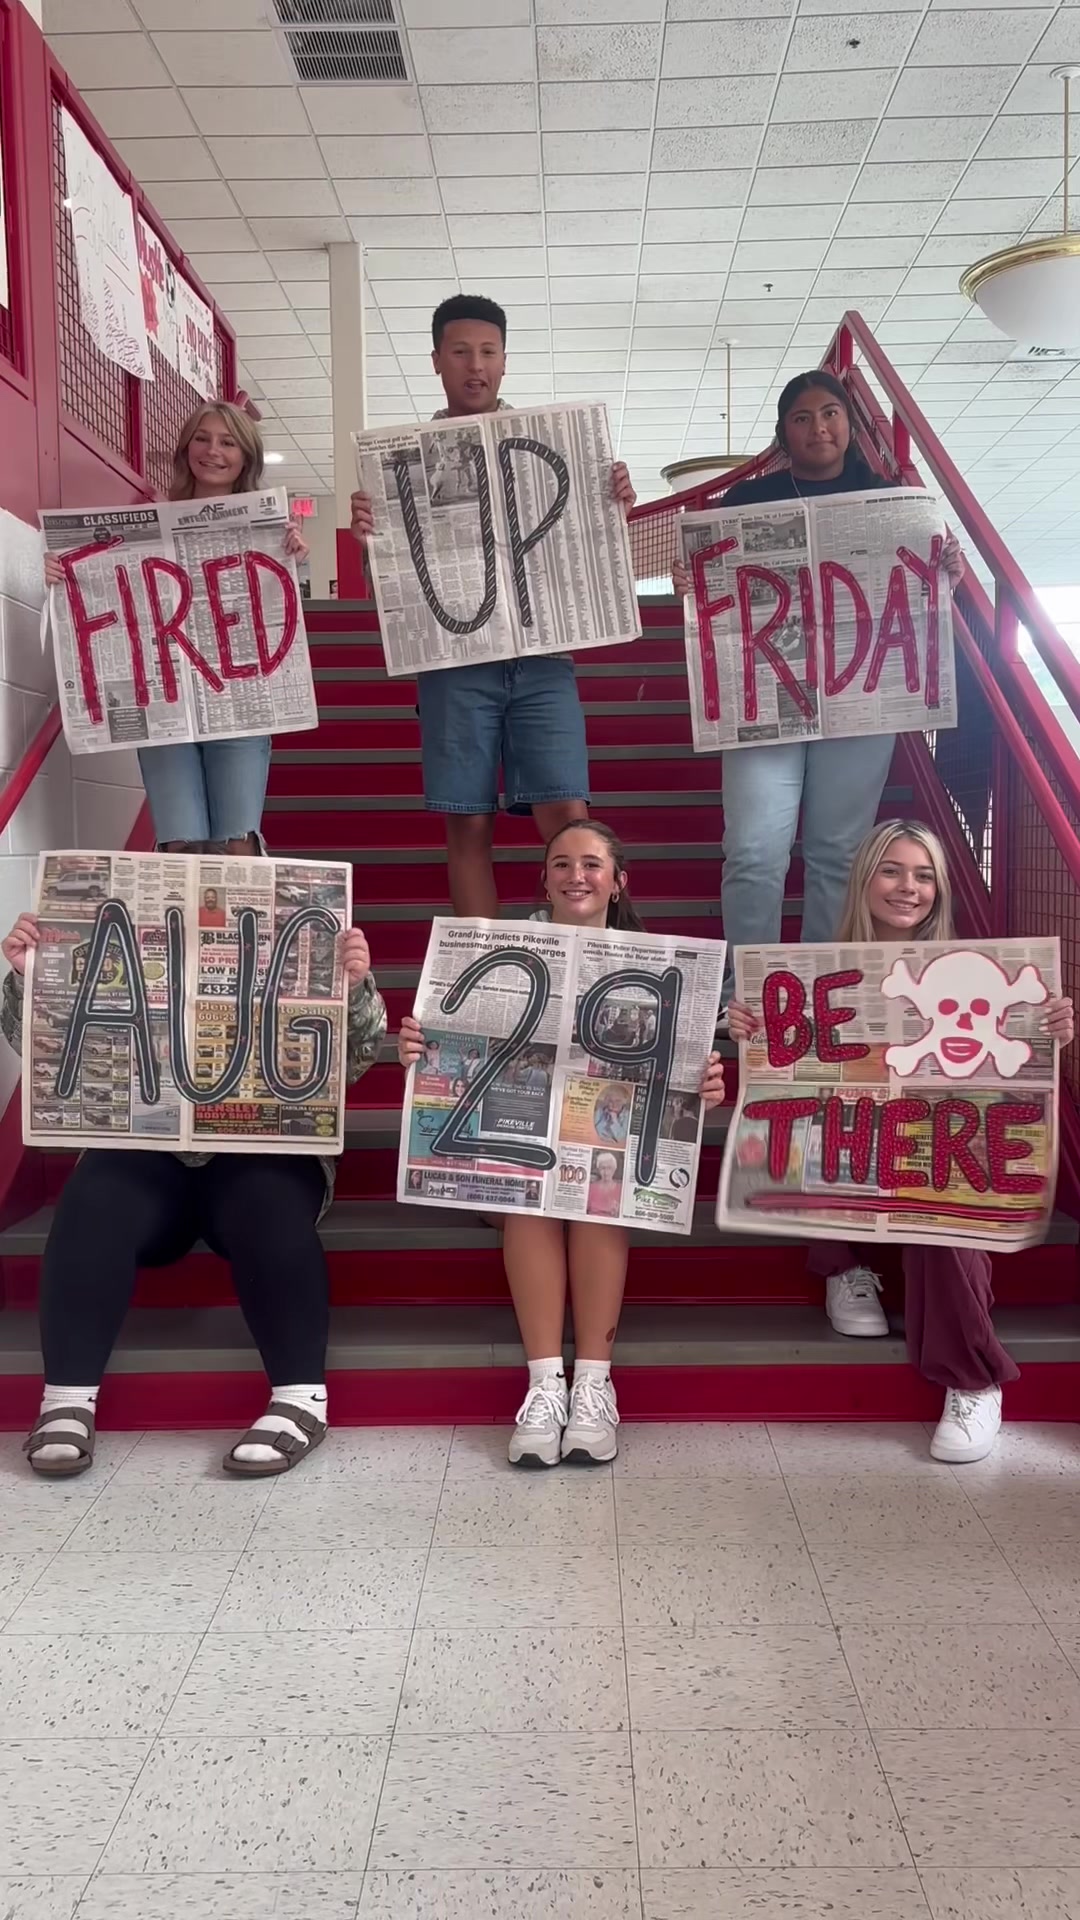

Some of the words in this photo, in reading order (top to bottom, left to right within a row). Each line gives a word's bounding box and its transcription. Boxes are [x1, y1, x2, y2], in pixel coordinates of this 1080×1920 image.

[83, 511, 155, 526] CLASSIFIEDS
[177, 505, 249, 526] ENTERTAINMENT
[393, 437, 570, 634] UP
[59, 535, 297, 724] FIRED
[691, 535, 943, 721] FRIDAY
[448, 930, 473, 939] Grand
[472, 931, 490, 941] jury
[492, 932, 520, 942] indicts
[522, 934, 560, 946] Pikeville
[439, 940, 493, 951] businessman
[530, 946, 566, 958] charges
[587, 941, 612, 950] Pikeville
[613, 944, 630, 952] Police
[631, 945, 666, 955] Department
[200, 956, 216, 964] NO
[201, 966, 226, 976] LOW
[55, 898, 340, 1105] AUG
[300, 1005, 338, 1016] Sales
[763, 969, 871, 1068] BE
[431, 947, 683, 1186] 29
[195, 1103, 259, 1113] HENSLEY
[228, 1112, 259, 1120] SHOP
[497, 1118, 535, 1127] PIKEVILLE
[743, 1095, 1048, 1194] THERE
[424, 1171, 446, 1181] LUCAS
[455, 1174, 471, 1183] SON
[472, 1174, 503, 1186] FUNERAL
[504, 1178, 525, 1187] HOME
